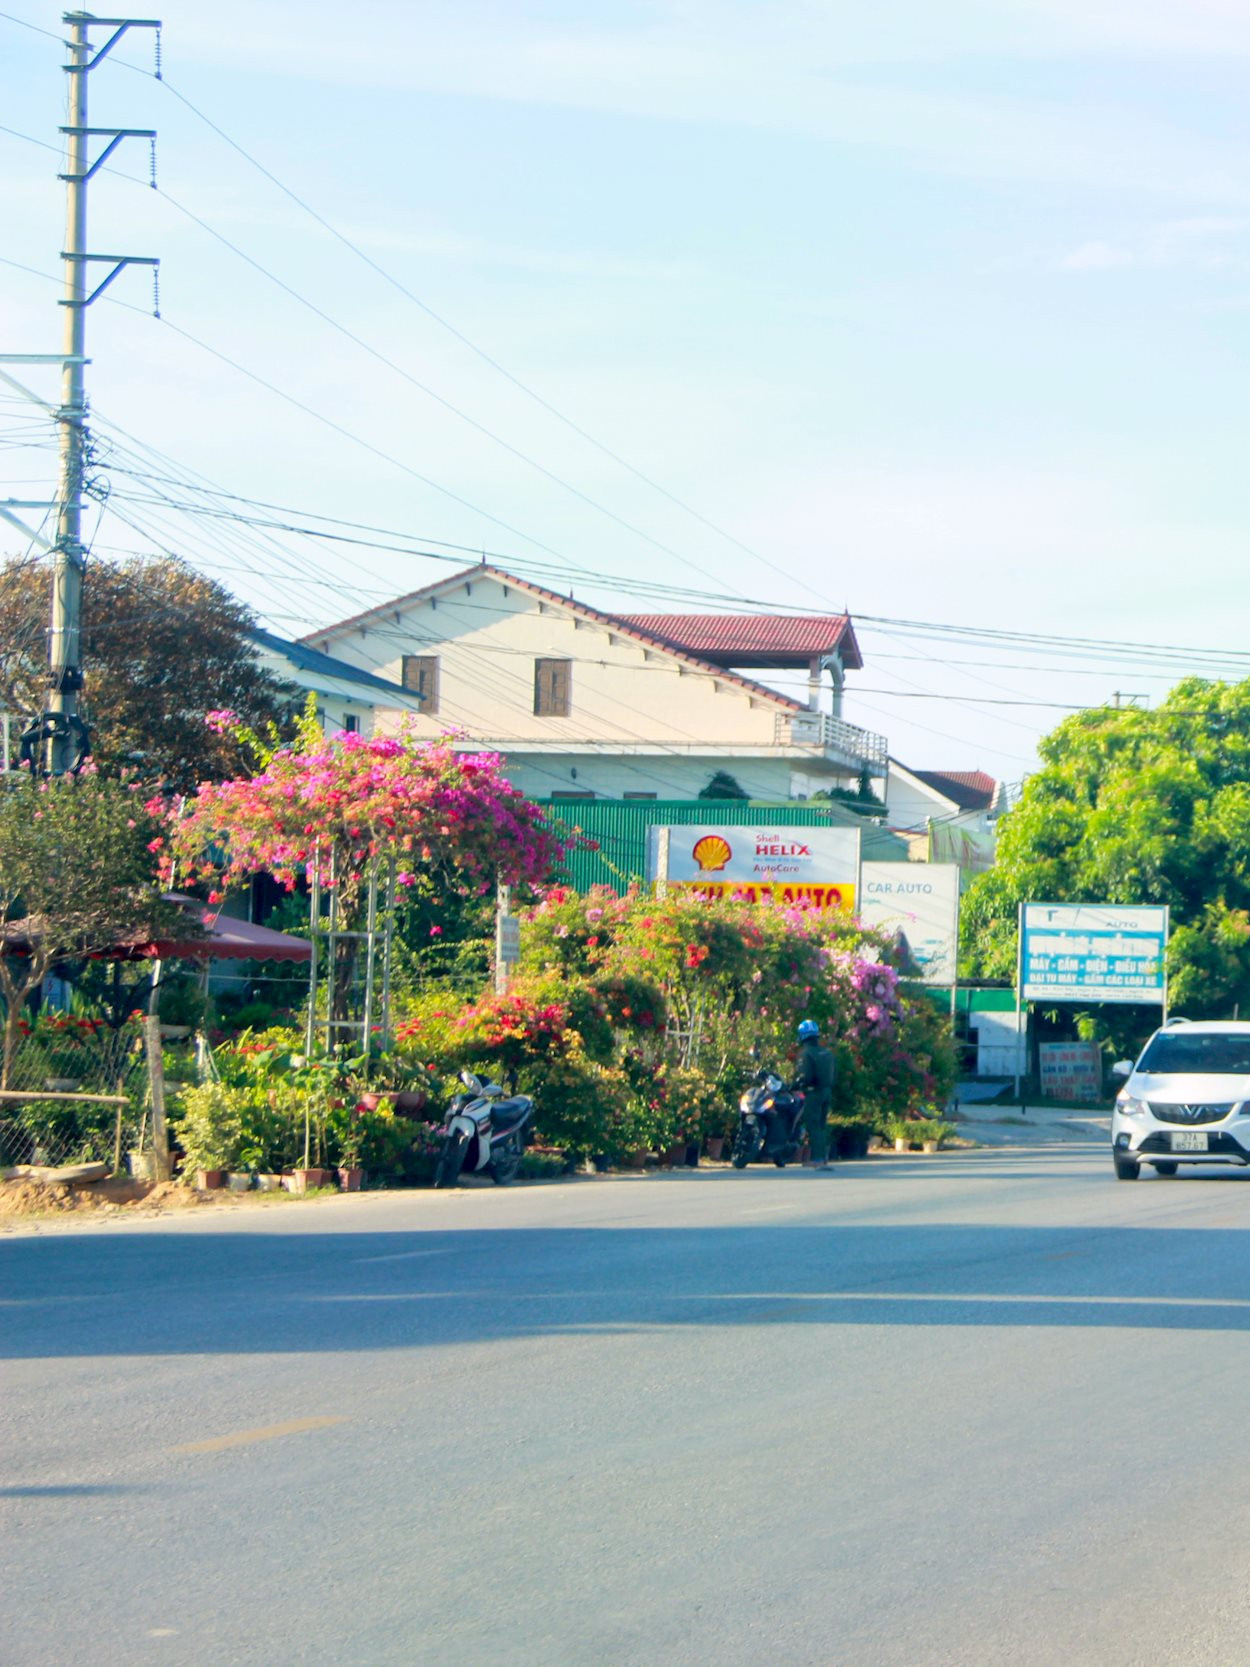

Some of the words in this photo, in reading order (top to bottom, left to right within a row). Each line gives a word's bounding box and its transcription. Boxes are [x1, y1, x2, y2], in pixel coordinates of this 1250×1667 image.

[756, 834, 780, 843] Shell
[756, 843, 812, 856] HELIX
[753, 864, 800, 873] AutoCare
[867, 883, 892, 893] CAR
[897, 883, 933, 894] AUTO
